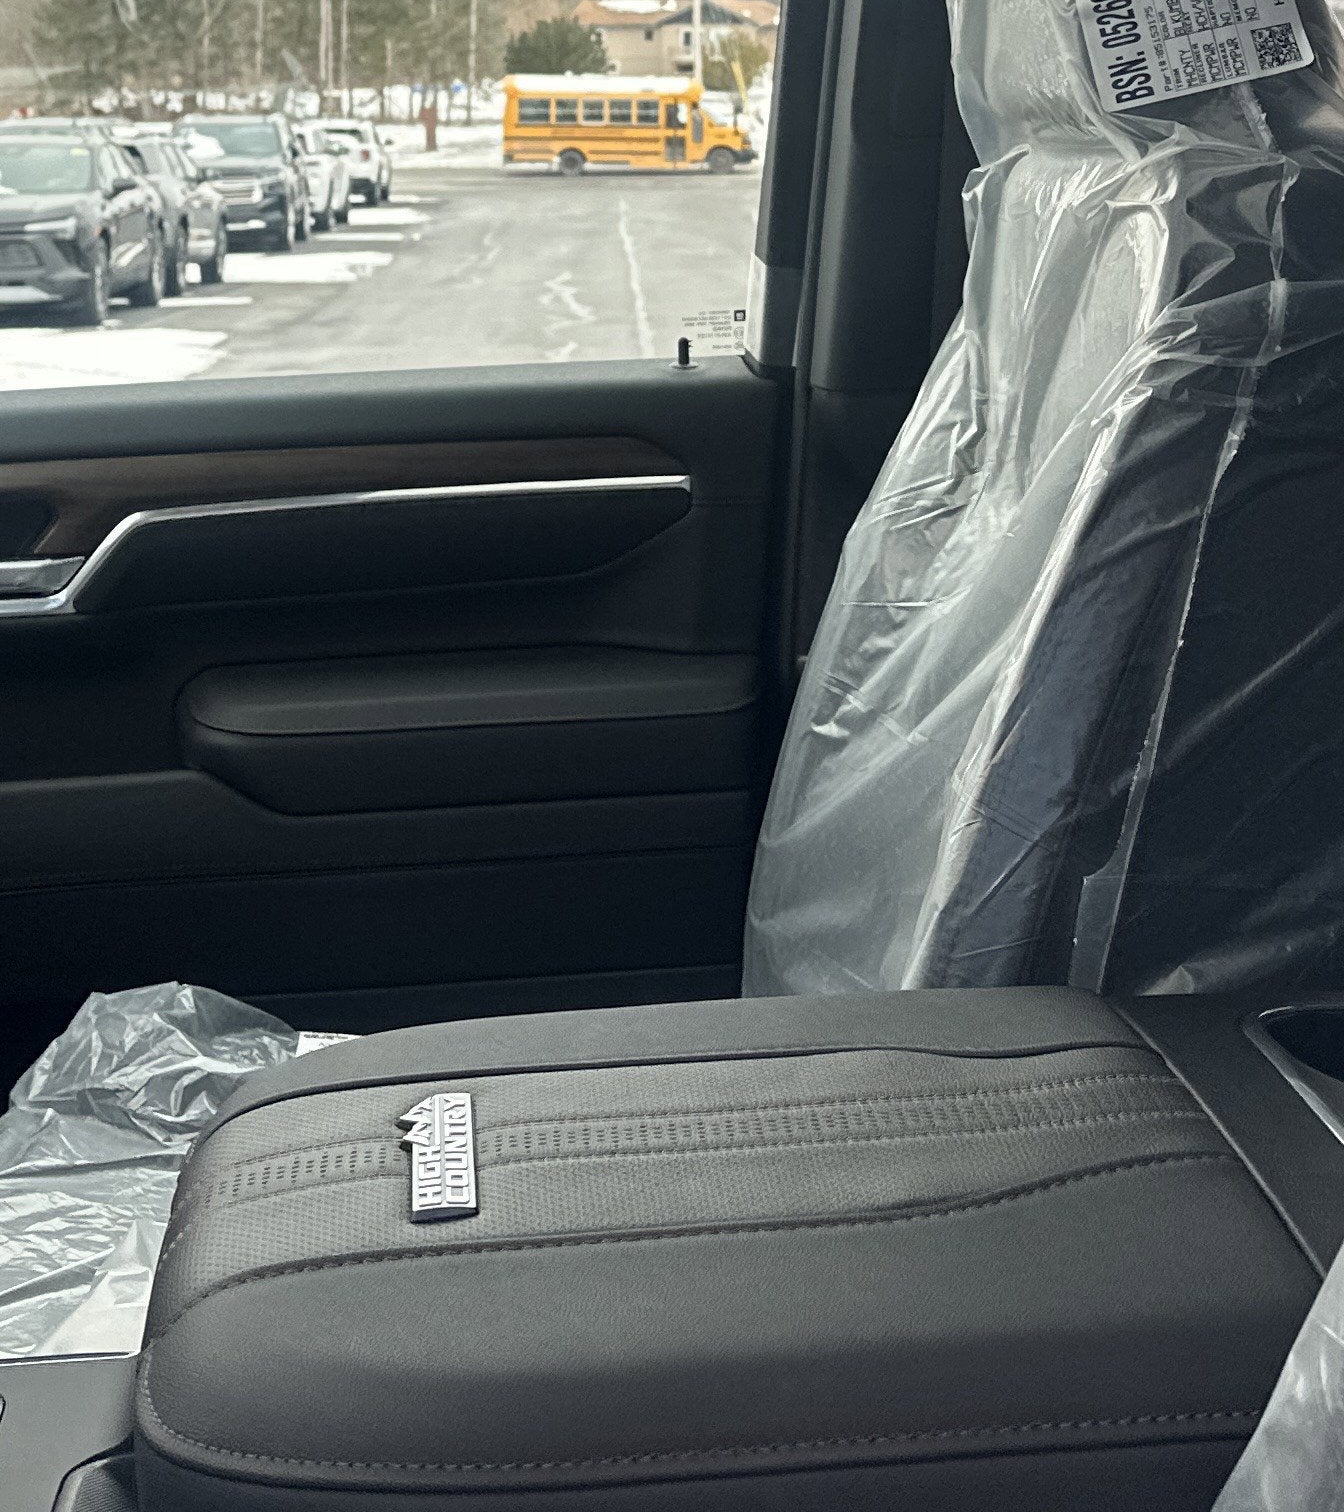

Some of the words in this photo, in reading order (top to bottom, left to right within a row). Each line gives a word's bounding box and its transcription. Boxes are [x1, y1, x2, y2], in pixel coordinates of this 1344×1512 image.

[1107, 50, 1155, 104] BSN:
[417, 1144, 443, 1207] HIGH
[443, 1098, 471, 1205] COUNTRY
